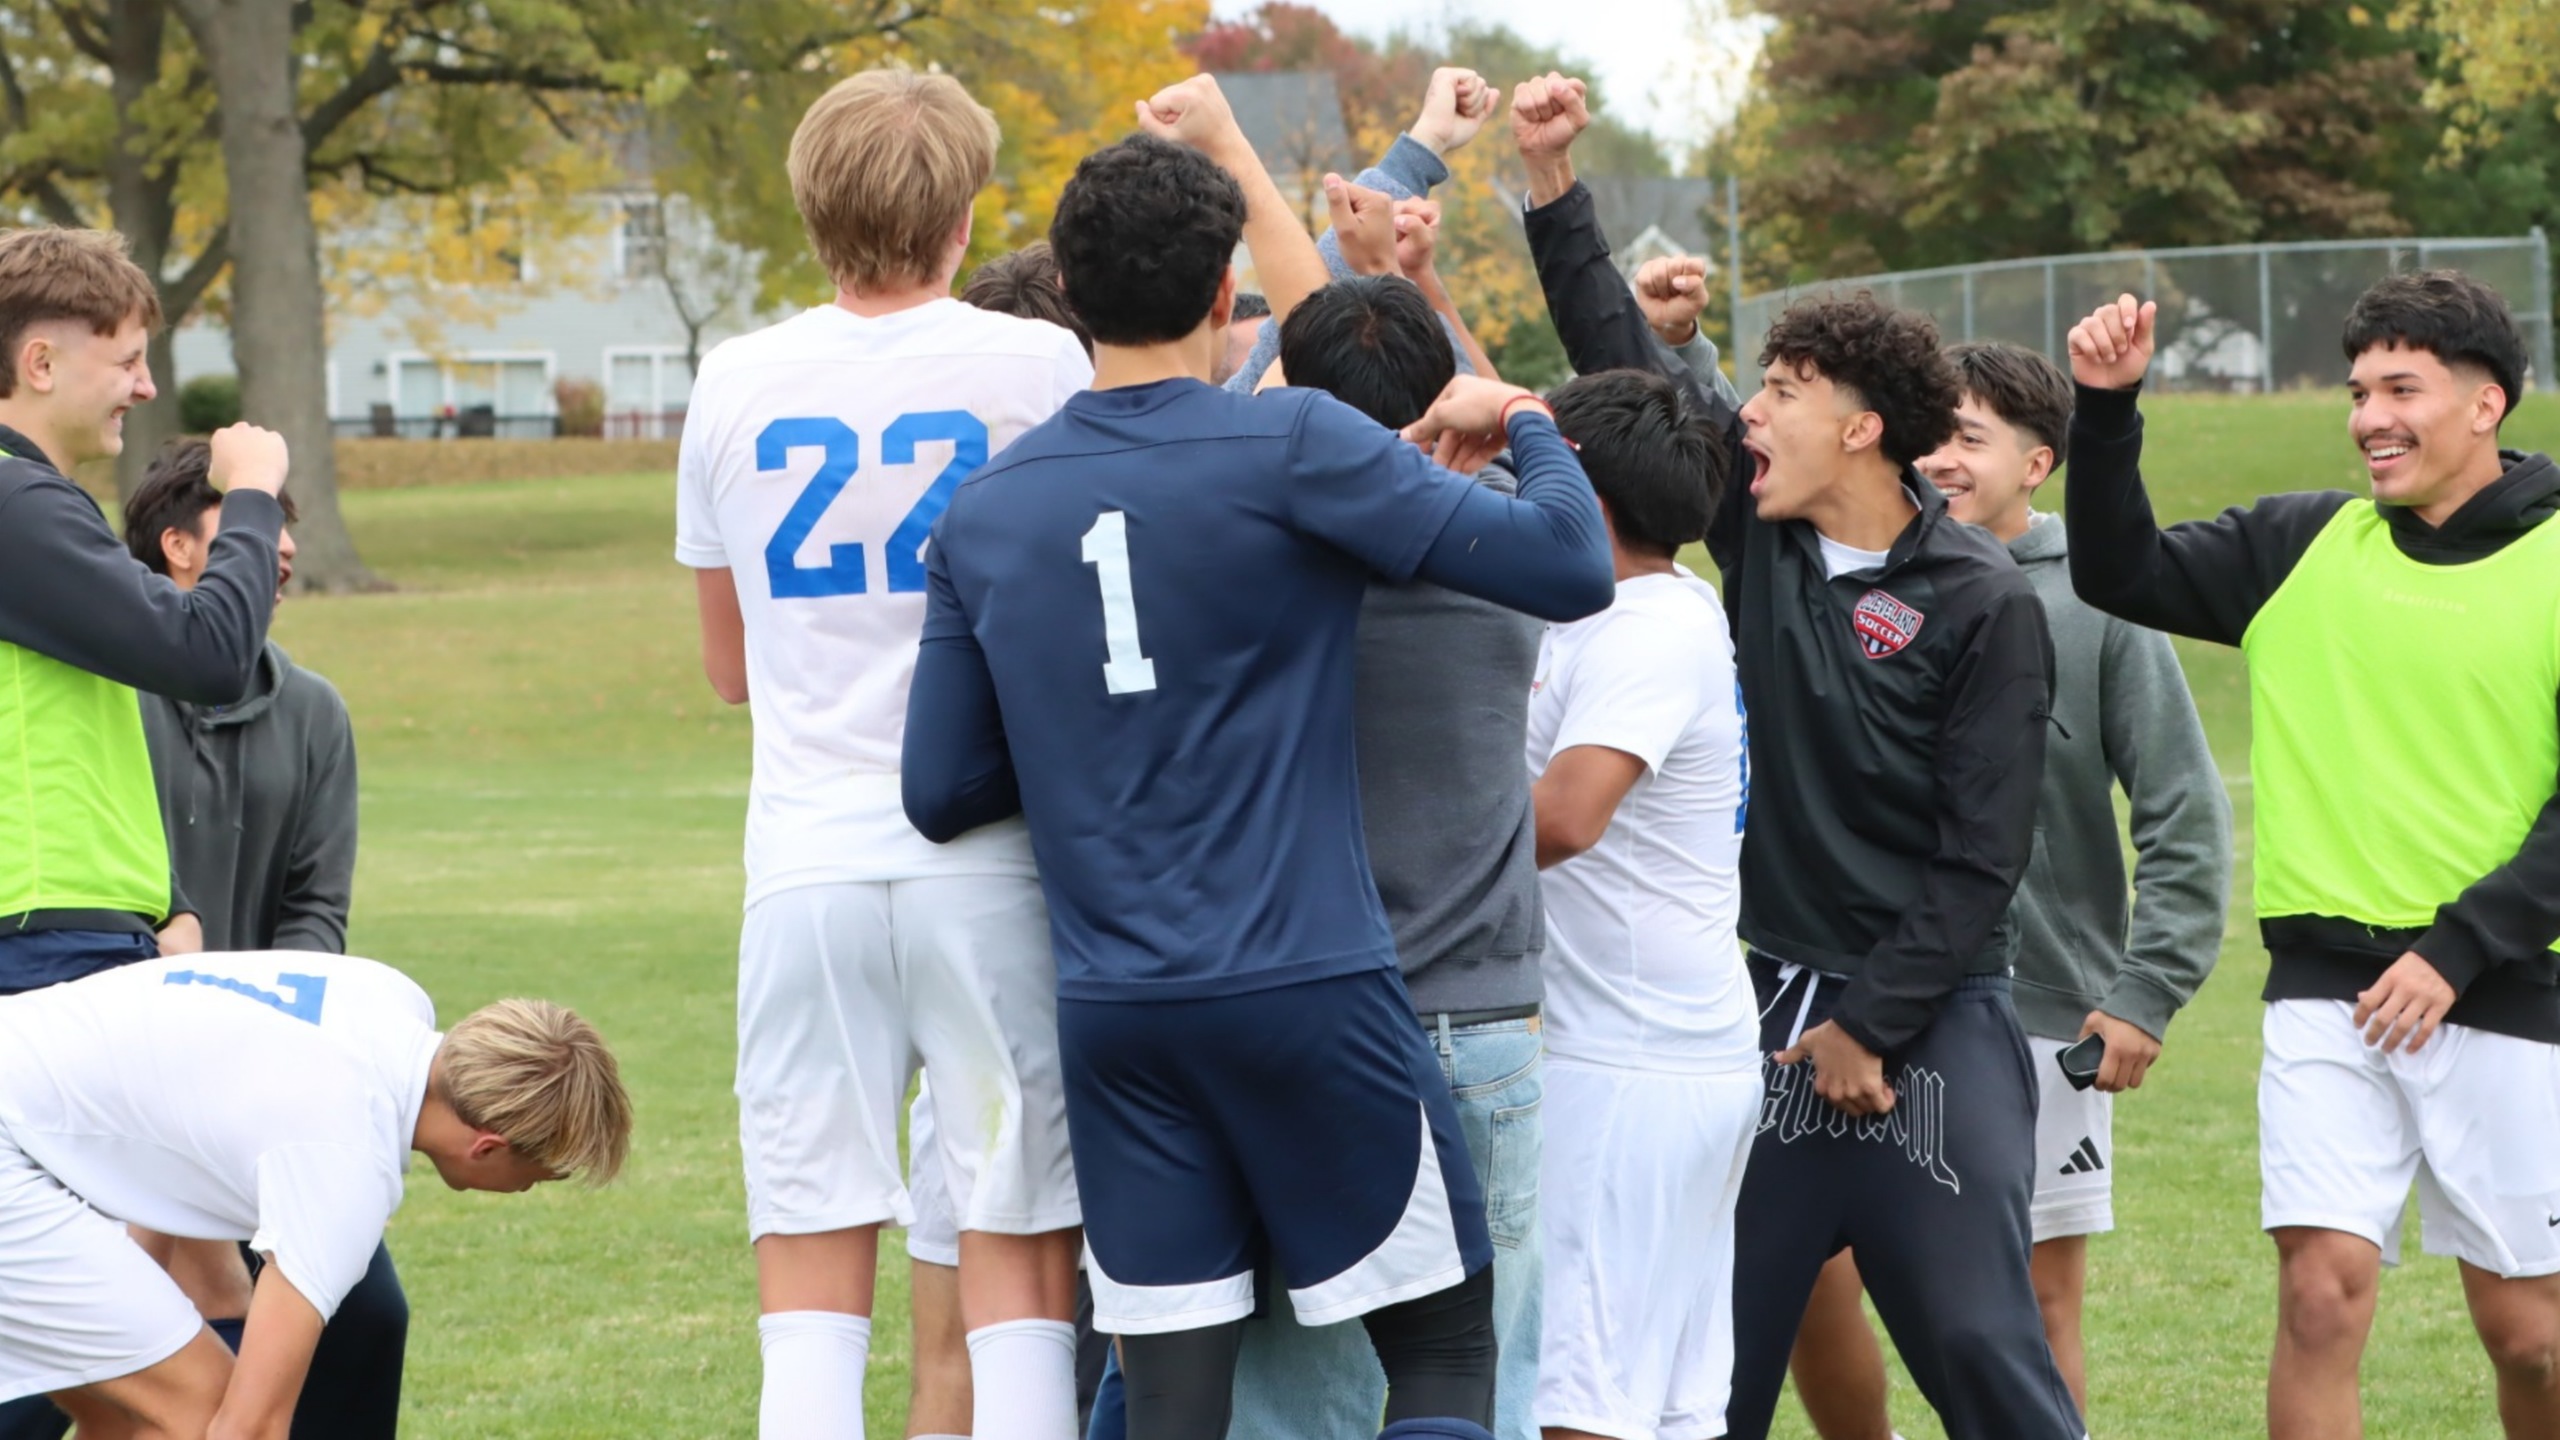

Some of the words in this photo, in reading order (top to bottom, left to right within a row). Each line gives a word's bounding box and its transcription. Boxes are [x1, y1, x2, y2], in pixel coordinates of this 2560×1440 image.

[756, 410, 988, 598] 22
[1081, 510, 1157, 695] 1
[1857, 614, 1903, 645] SOCCER
[163, 970, 328, 1026] 7
